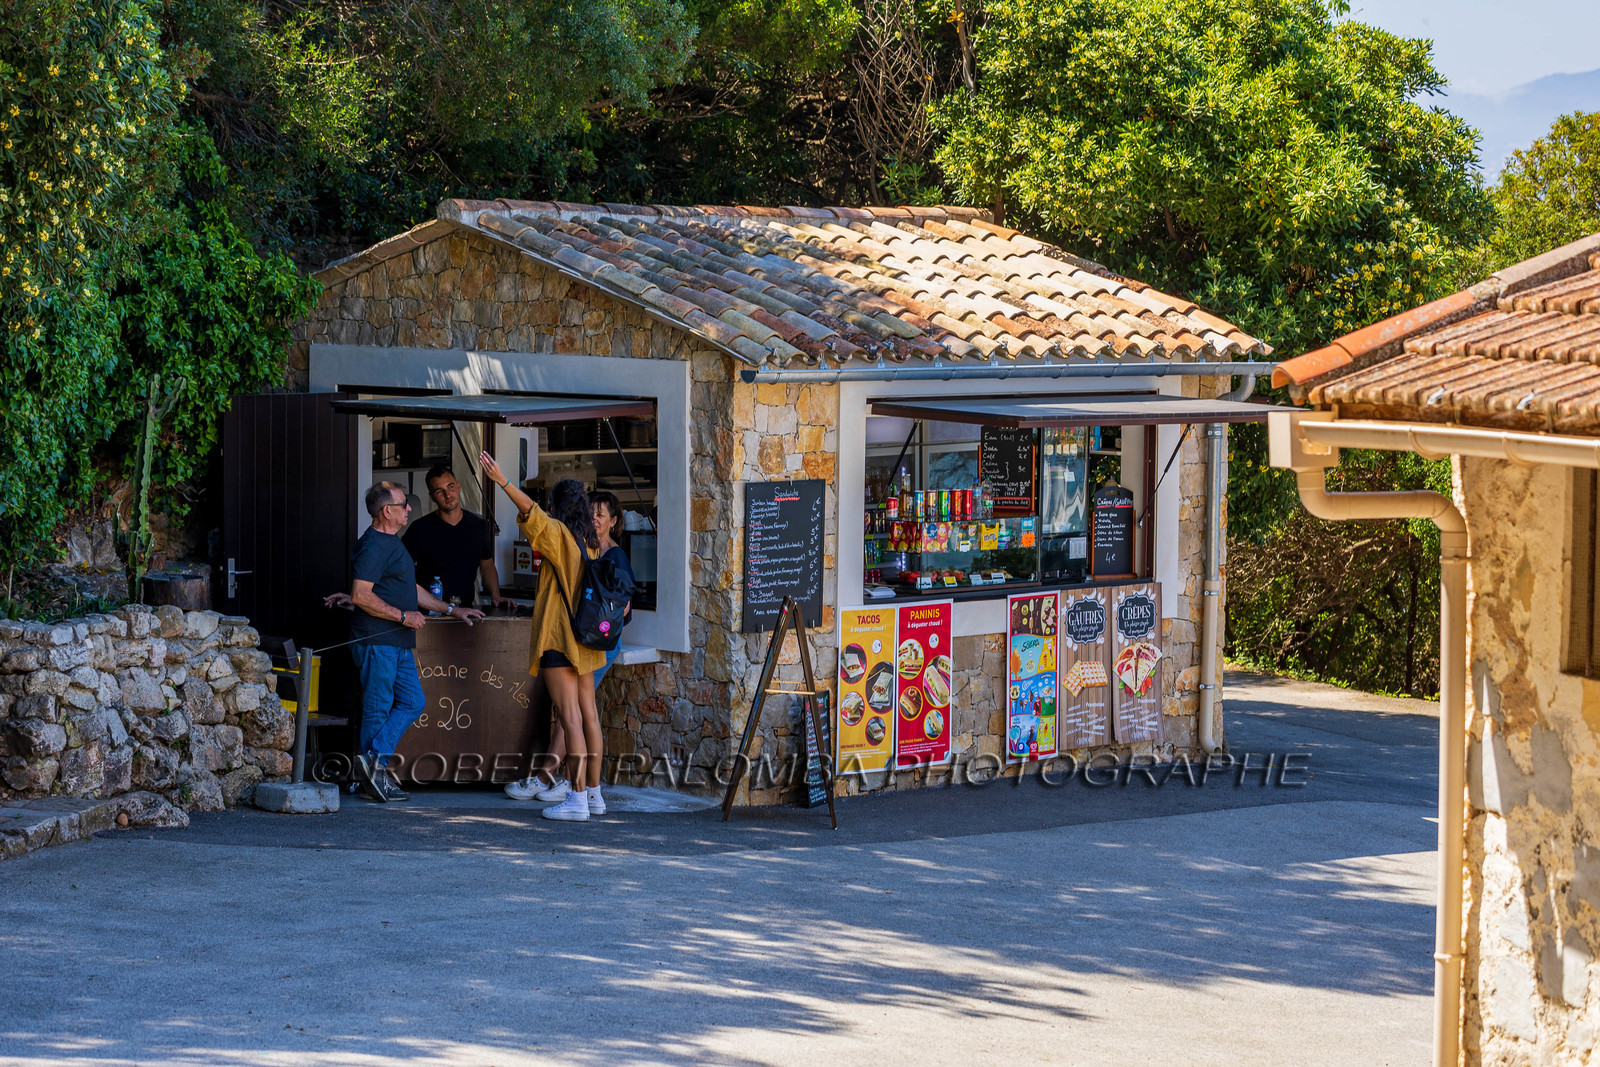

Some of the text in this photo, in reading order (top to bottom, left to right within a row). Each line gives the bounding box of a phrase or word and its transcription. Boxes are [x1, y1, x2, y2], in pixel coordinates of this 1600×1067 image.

[984, 442, 998, 452] Soda
[857, 614, 880, 625] TACOS
[910, 608, 940, 620] PANINIS
[1068, 610, 1102, 626] GAUFRES
[1122, 604, 1150, 620] CRÊPES
[418, 658, 530, 708] bane des îles
[412, 696, 472, 730] e 26
